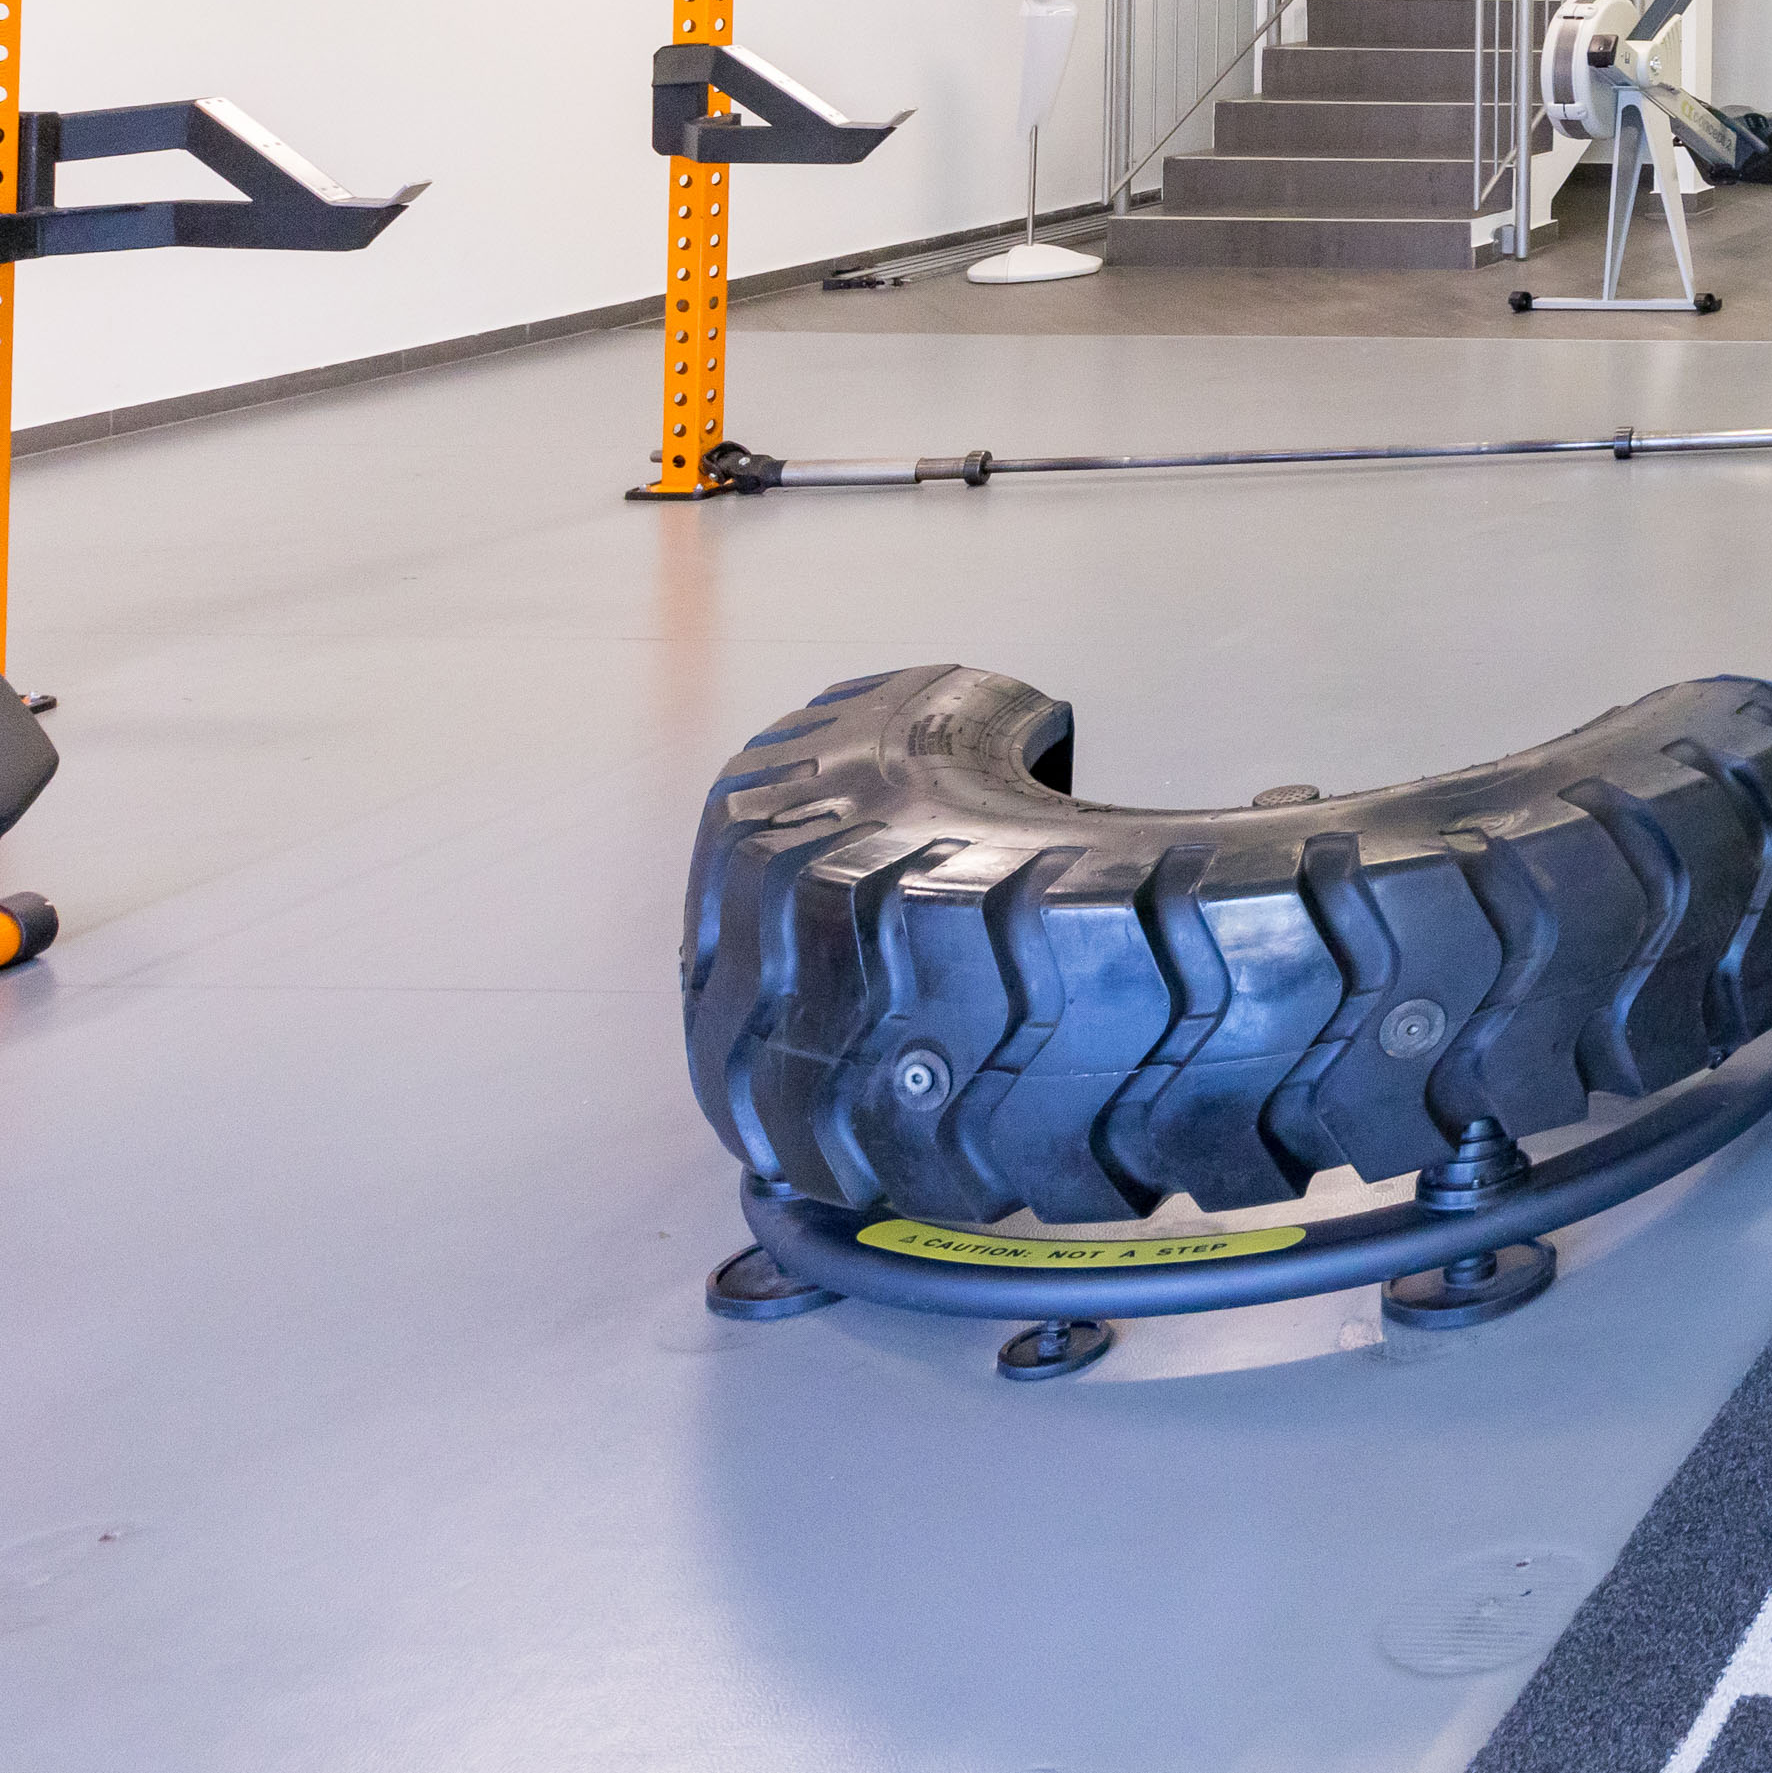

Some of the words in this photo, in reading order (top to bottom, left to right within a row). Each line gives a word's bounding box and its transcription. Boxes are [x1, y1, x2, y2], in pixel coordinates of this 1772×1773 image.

[922, 1237, 1033, 1259] CAUTION:
[1047, 1249, 1106, 1260] NOT
[1118, 1249, 1137, 1259] A
[1156, 1242, 1228, 1256] STEP
